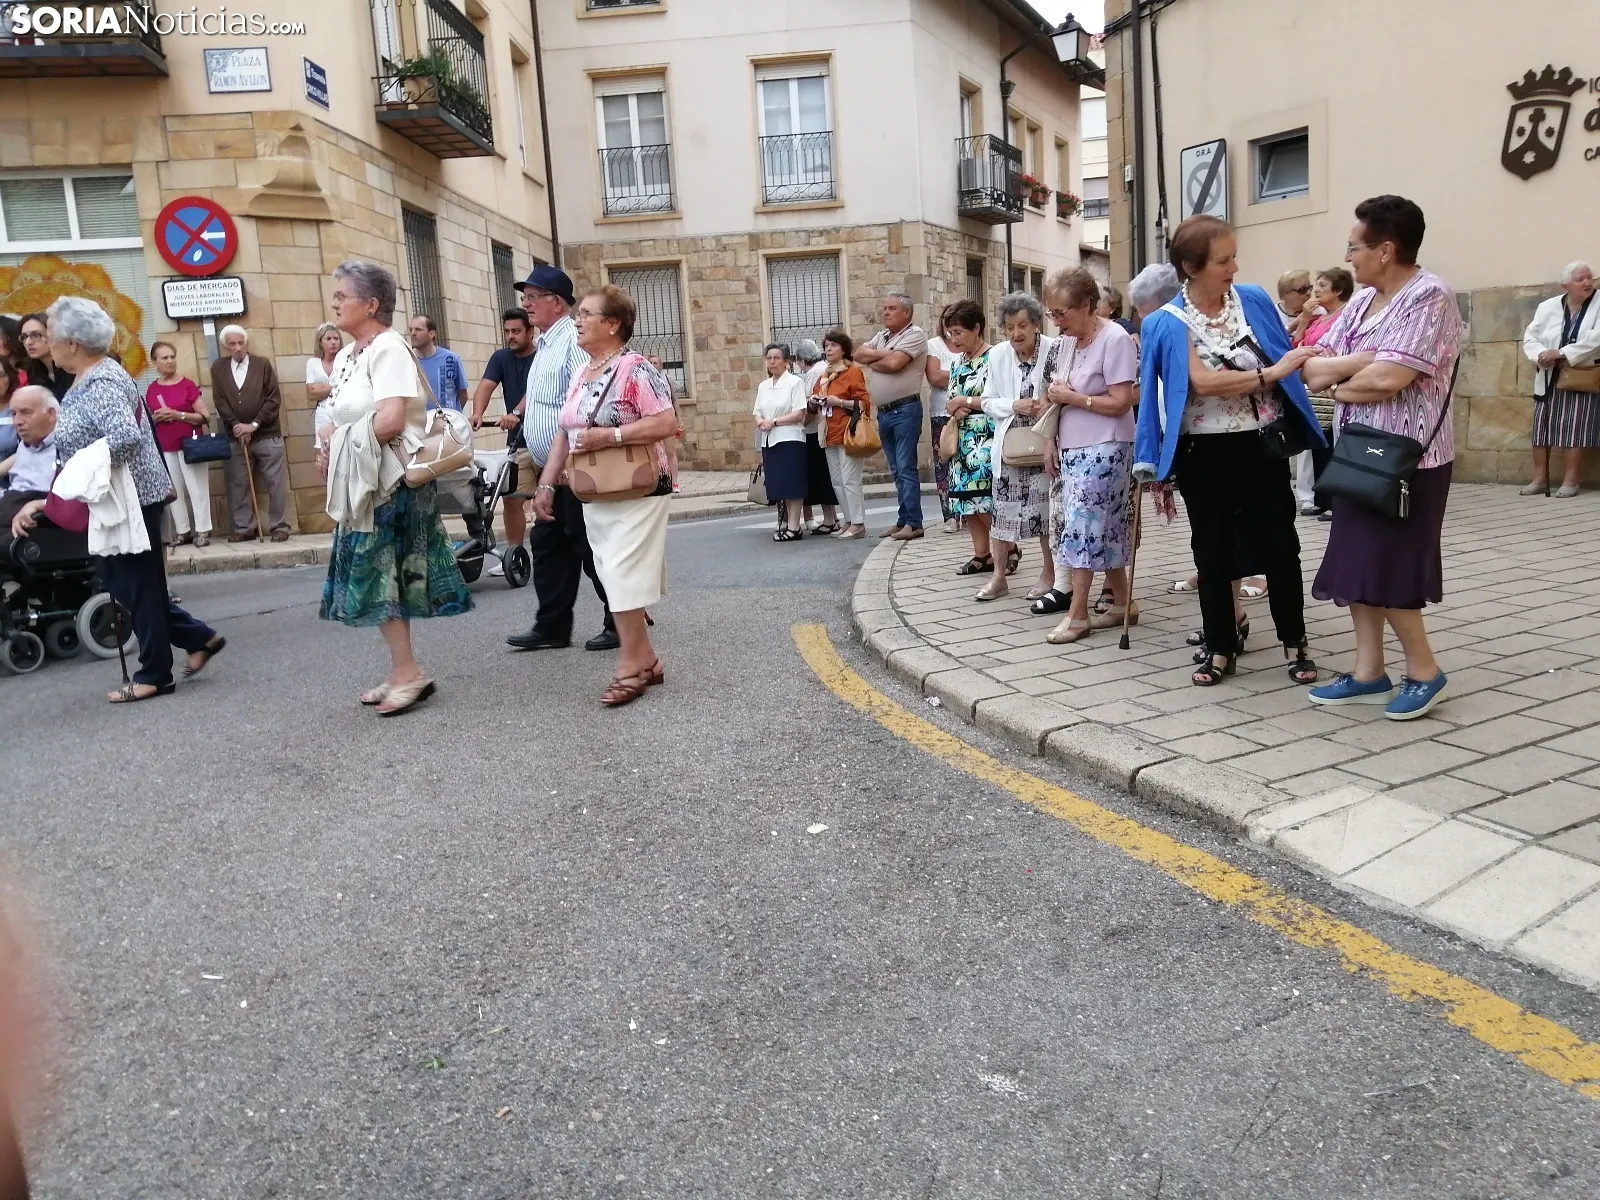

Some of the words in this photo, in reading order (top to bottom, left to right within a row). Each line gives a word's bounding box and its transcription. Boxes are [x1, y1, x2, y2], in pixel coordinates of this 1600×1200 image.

[231, 56, 262, 67] PLAZA
[166, 284, 185, 292] DIAS
[187, 283, 198, 291] DE
[199, 281, 239, 291] MERCADO
[204, 298, 241, 306] ANTERIORES
